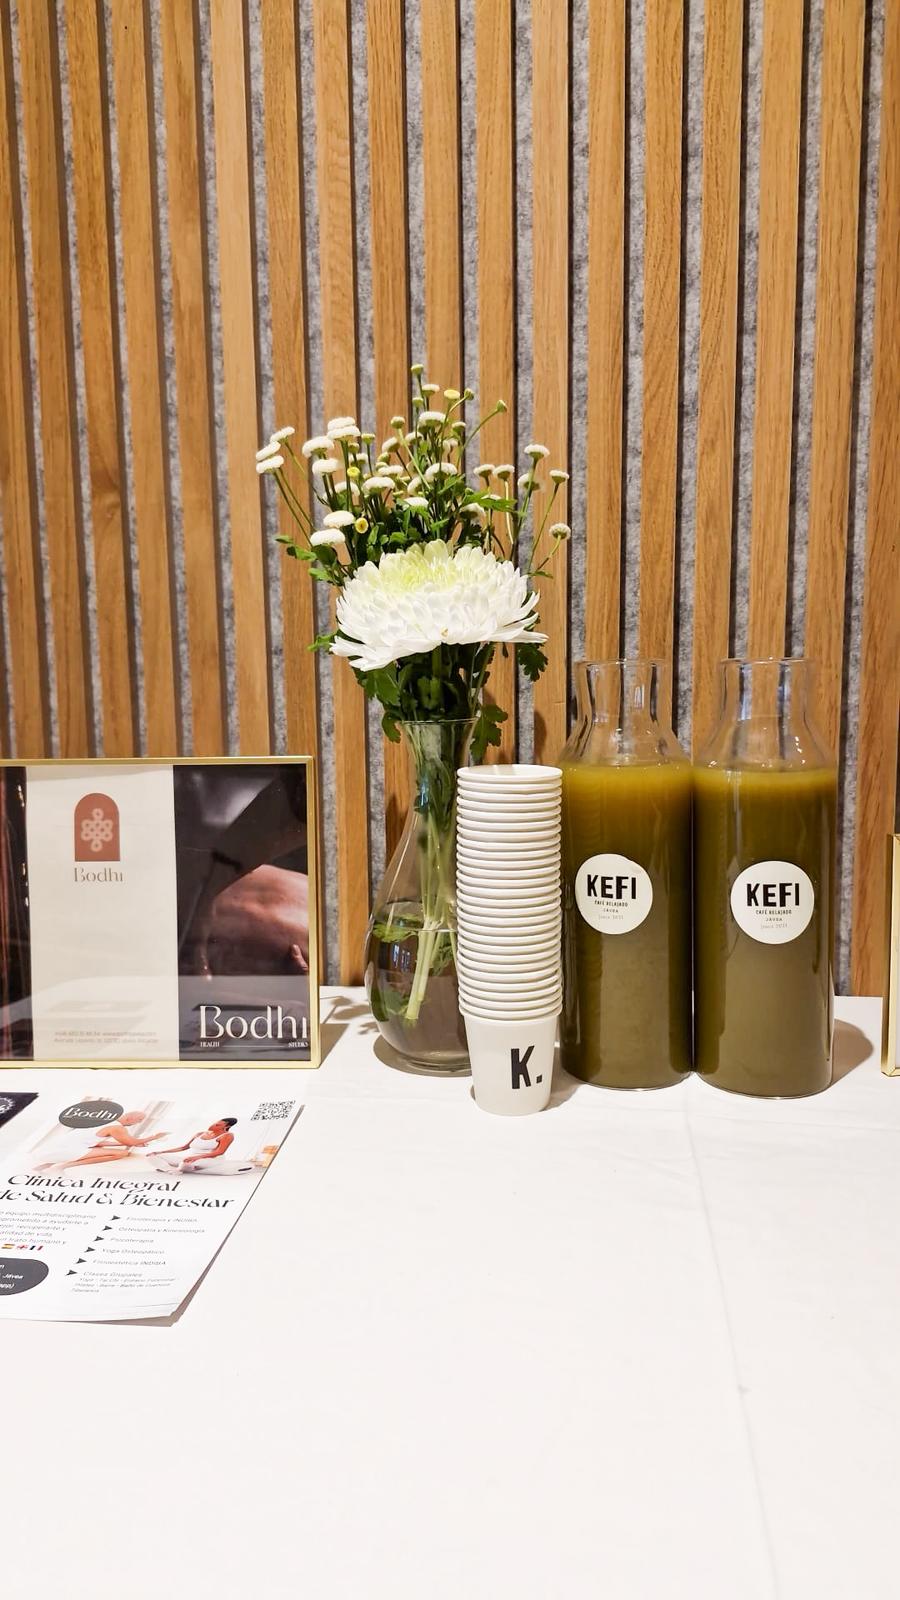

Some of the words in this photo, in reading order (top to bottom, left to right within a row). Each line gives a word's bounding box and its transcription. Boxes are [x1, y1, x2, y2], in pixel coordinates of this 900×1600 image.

[74, 867, 124, 882] Bodhi
[586, 874, 637, 900] KEFI
[746, 882, 800, 908] KEFI
[200, 1005, 308, 1039] Bodhi
[510, 1045, 543, 1090] K.
[63, 1107, 119, 1121] Bodhi
[90, 1177, 181, 1194] Integral
[26, 1190, 94, 1204] Salud
[96, 1193, 113, 1205] &
[120, 1193, 235, 1208] Bienestar
